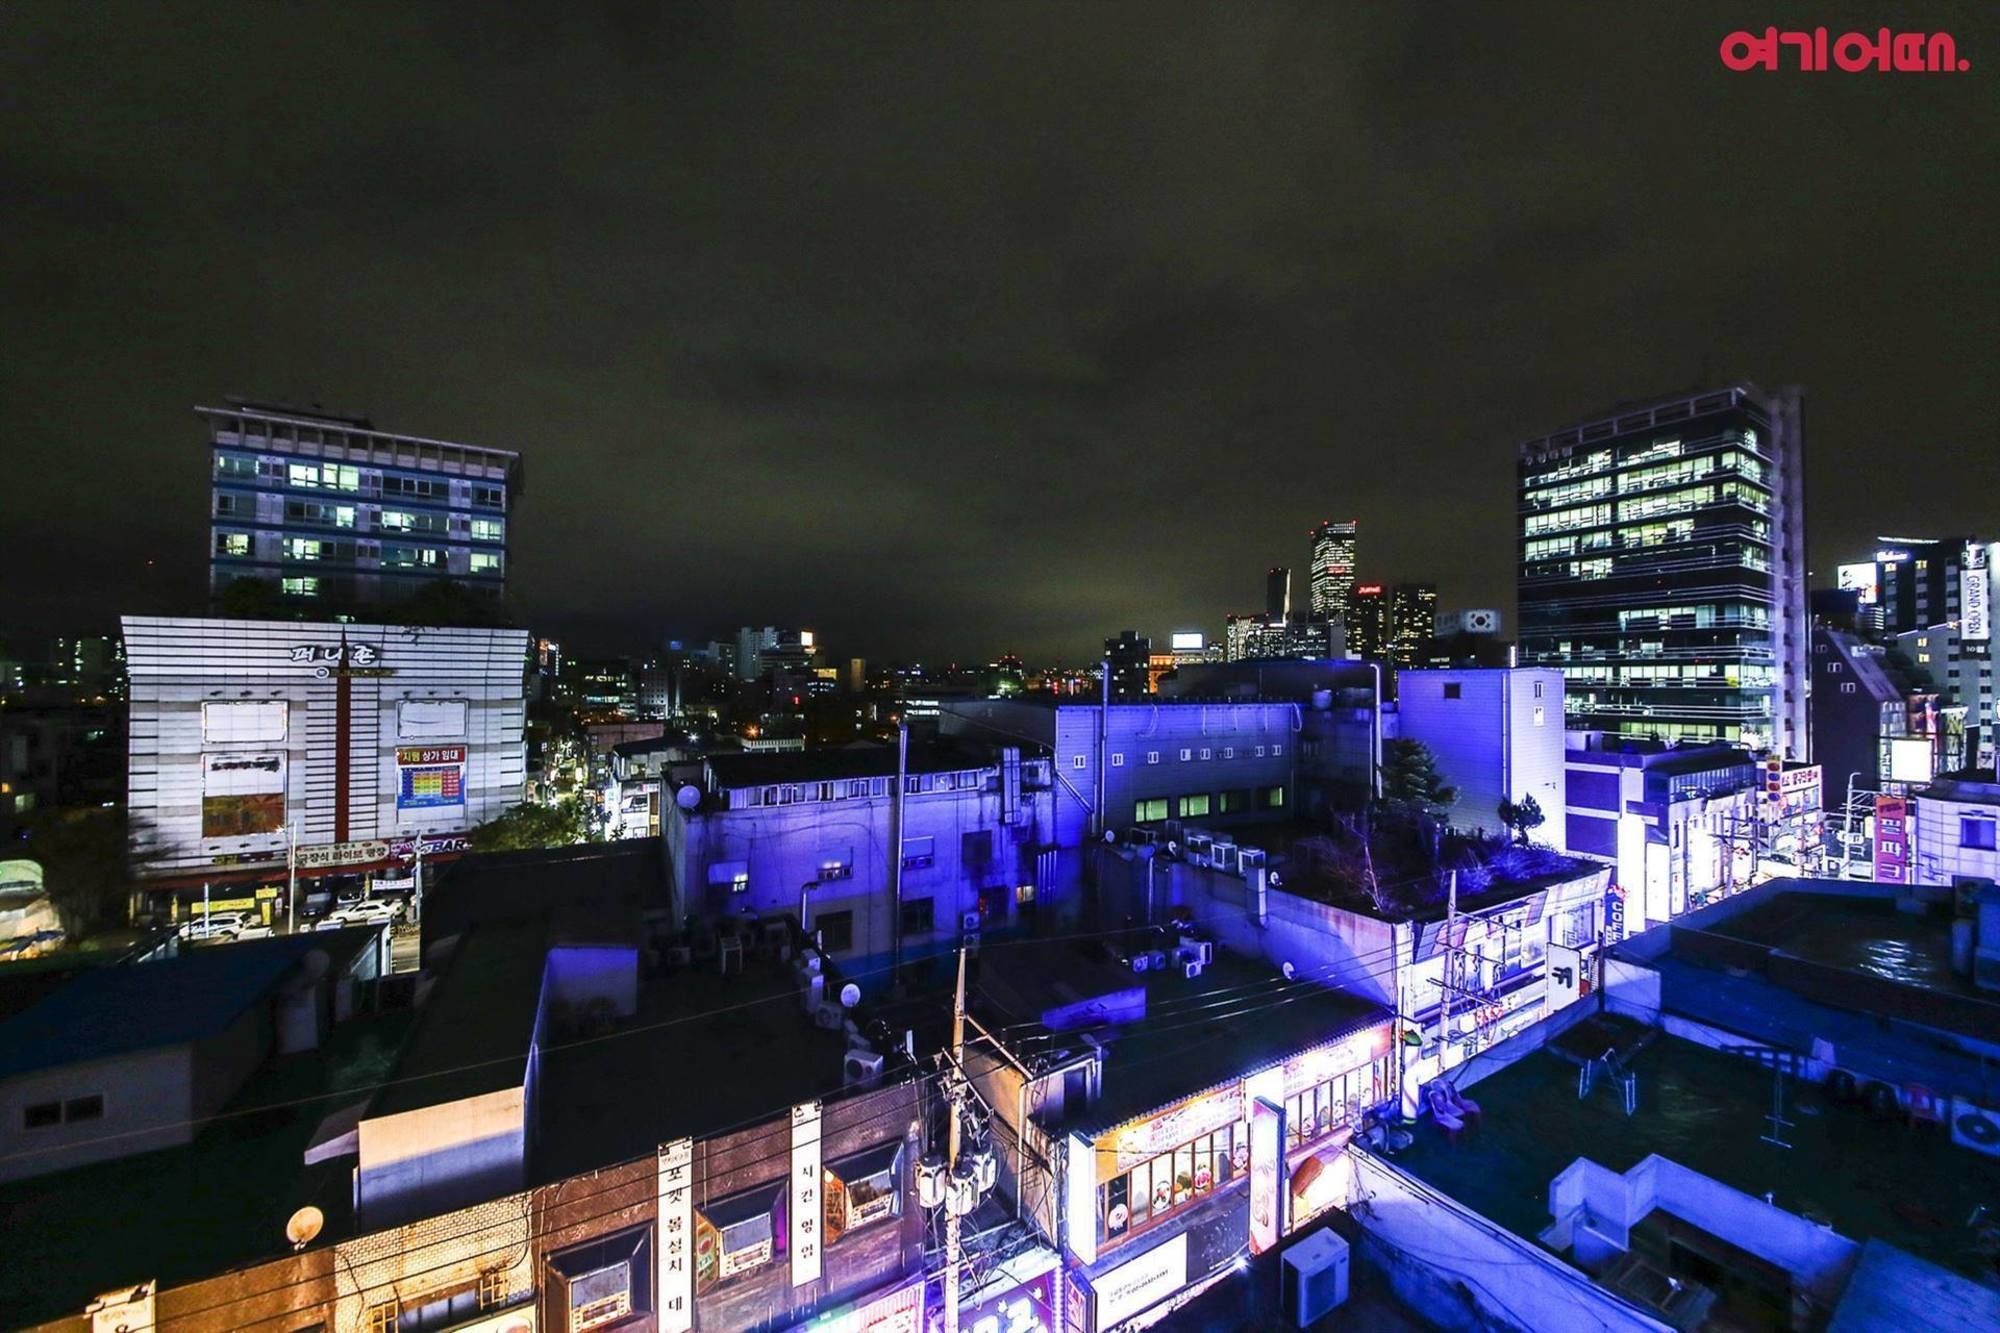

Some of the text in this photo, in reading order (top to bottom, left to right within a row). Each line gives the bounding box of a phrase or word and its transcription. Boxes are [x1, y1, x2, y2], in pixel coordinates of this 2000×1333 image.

[1967, 575, 1981, 609] GRAND
[1968, 611, 1981, 635] OPEN
[332, 850, 363, 860] 라이브
[432, 840, 464, 853] BAR
